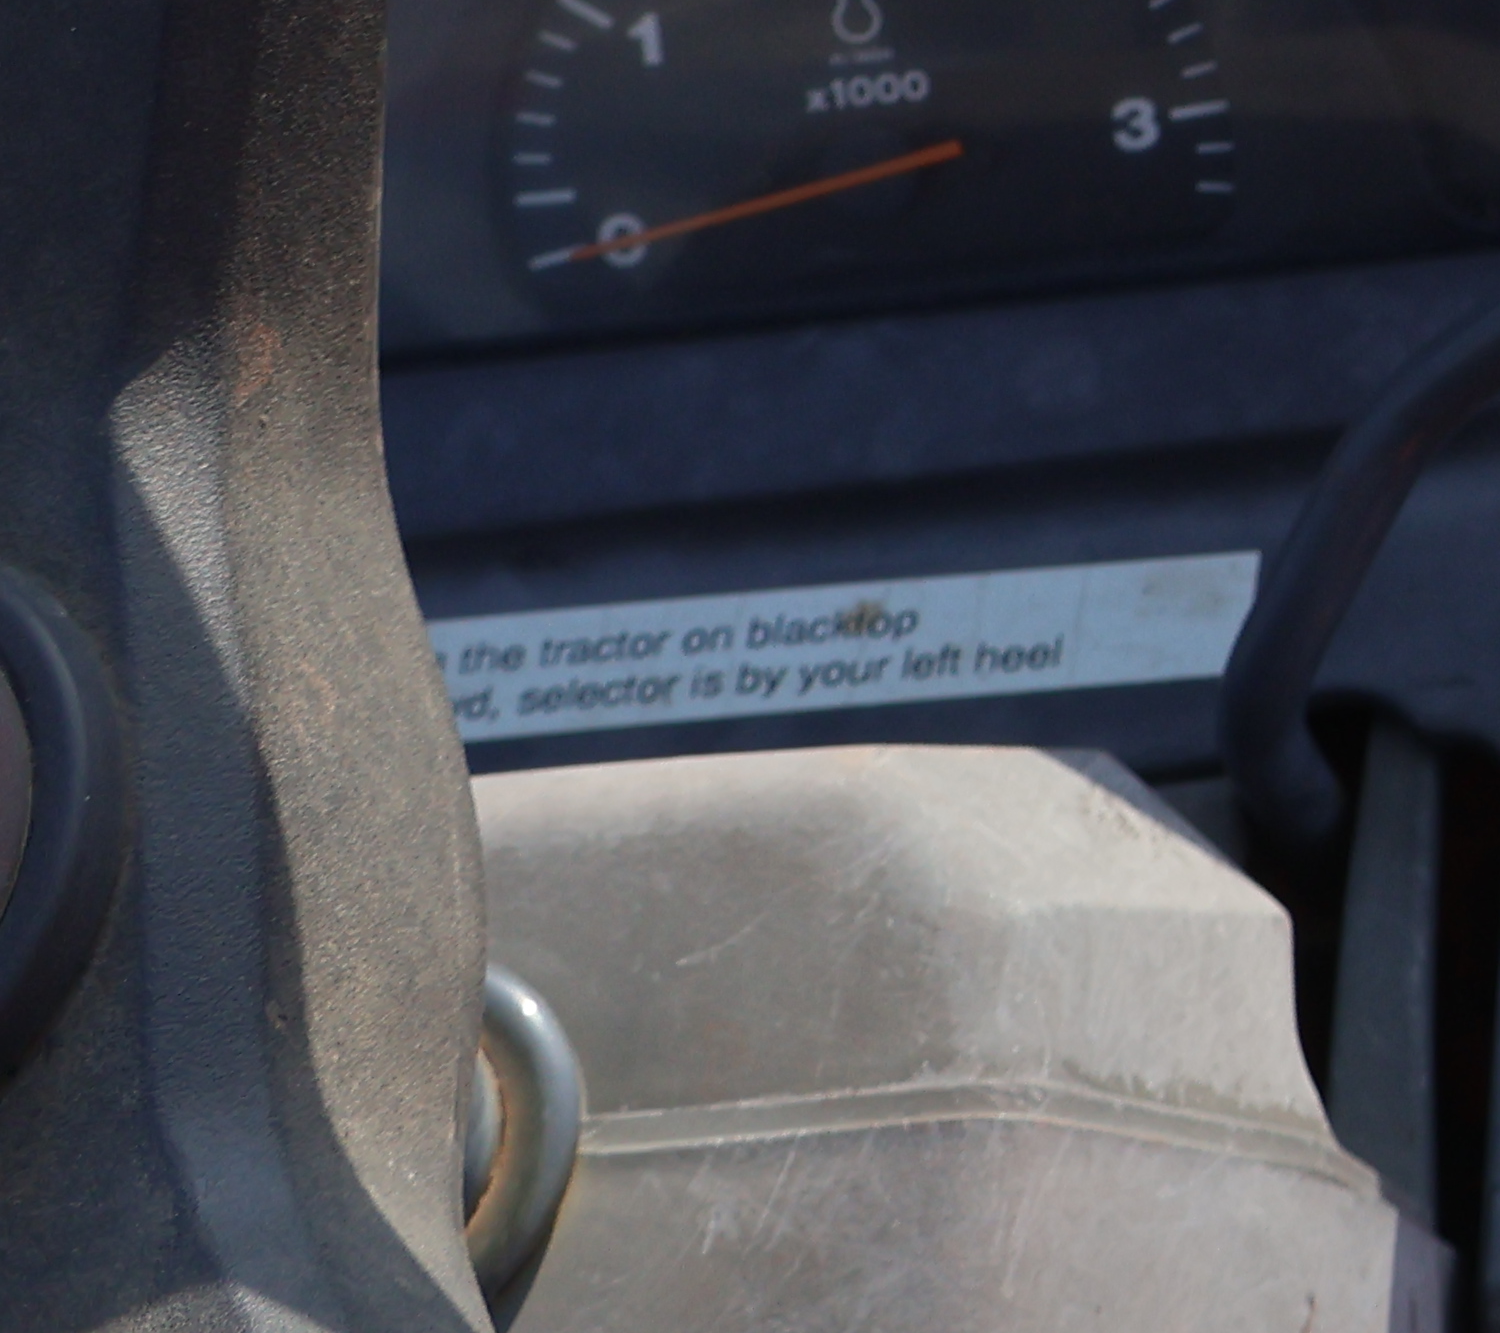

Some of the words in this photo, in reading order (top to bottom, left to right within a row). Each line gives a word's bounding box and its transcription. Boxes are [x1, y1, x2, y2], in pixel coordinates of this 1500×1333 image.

[627, 12, 665, 67] 1
[806, 69, 930, 113] x1000
[1110, 98, 1161, 153] 3
[597, 213, 649, 268] 0
[458, 641, 527, 675] the
[539, 629, 672, 669] tractor
[681, 625, 735, 657] on
[745, 608, 922, 651] blacktop
[516, 671, 680, 717] selector
[688, 664, 726, 699] is
[735, 660, 788, 698] by
[797, 653, 893, 696] your
[901, 642, 963, 680] left
[974, 632, 1065, 674] heel
